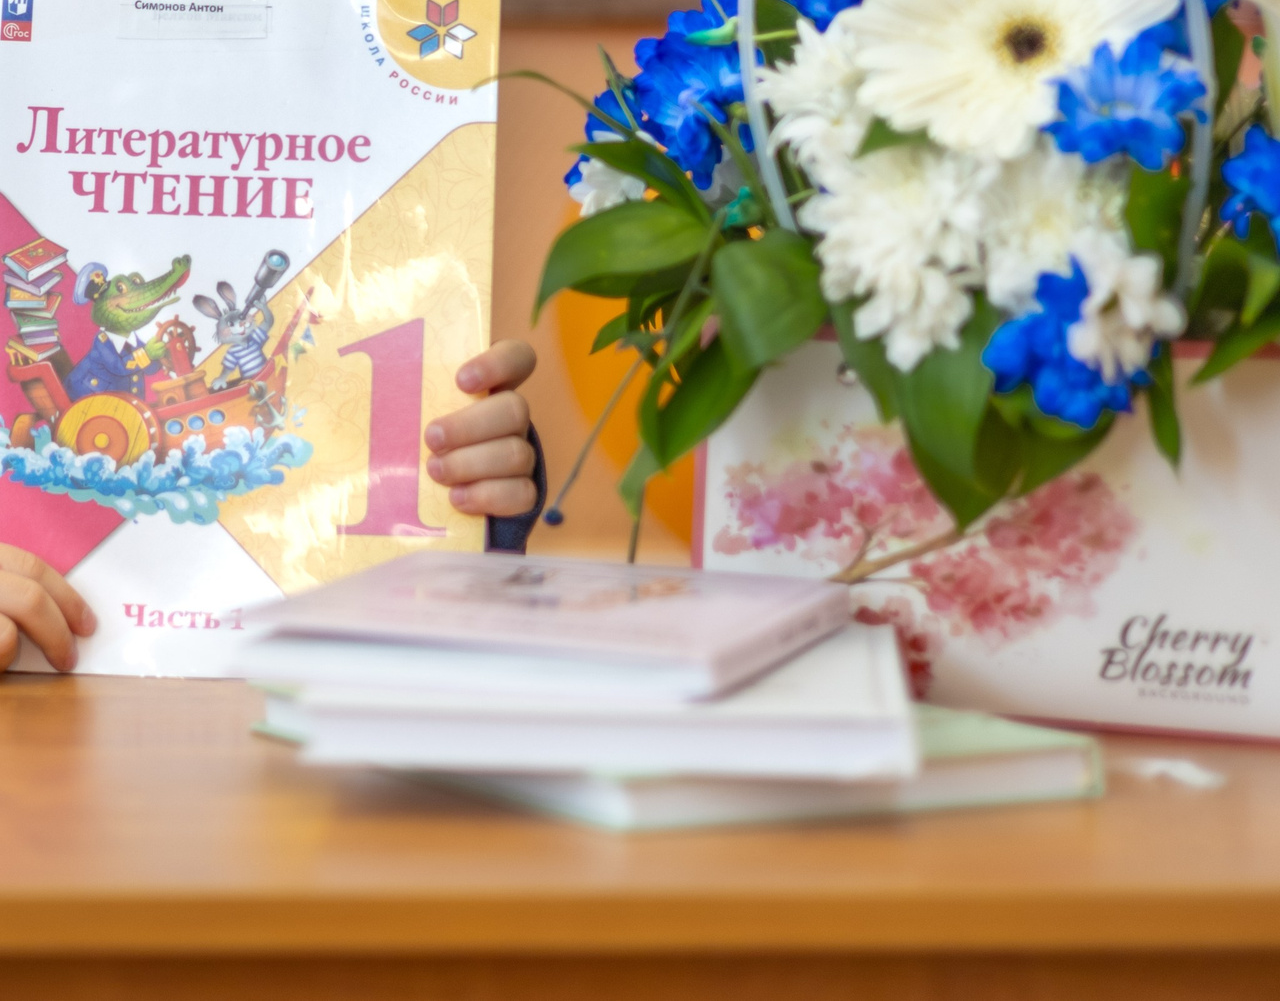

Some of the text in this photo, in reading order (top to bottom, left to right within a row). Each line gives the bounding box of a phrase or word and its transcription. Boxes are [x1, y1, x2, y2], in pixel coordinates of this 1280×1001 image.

[134, 0, 224, 13] Симонов Антон
[360, 5, 459, 105] ШКОЛА РОССИИ
[16, 106, 372, 172] Литературное
[68, 170, 315, 220] ЧТЕНИЕ
[336, 317, 447, 537] 1
[122, 603, 245, 631] Часть 1
[1120, 613, 1254, 667] Cherry
[1099, 647, 1253, 689] Blossom
